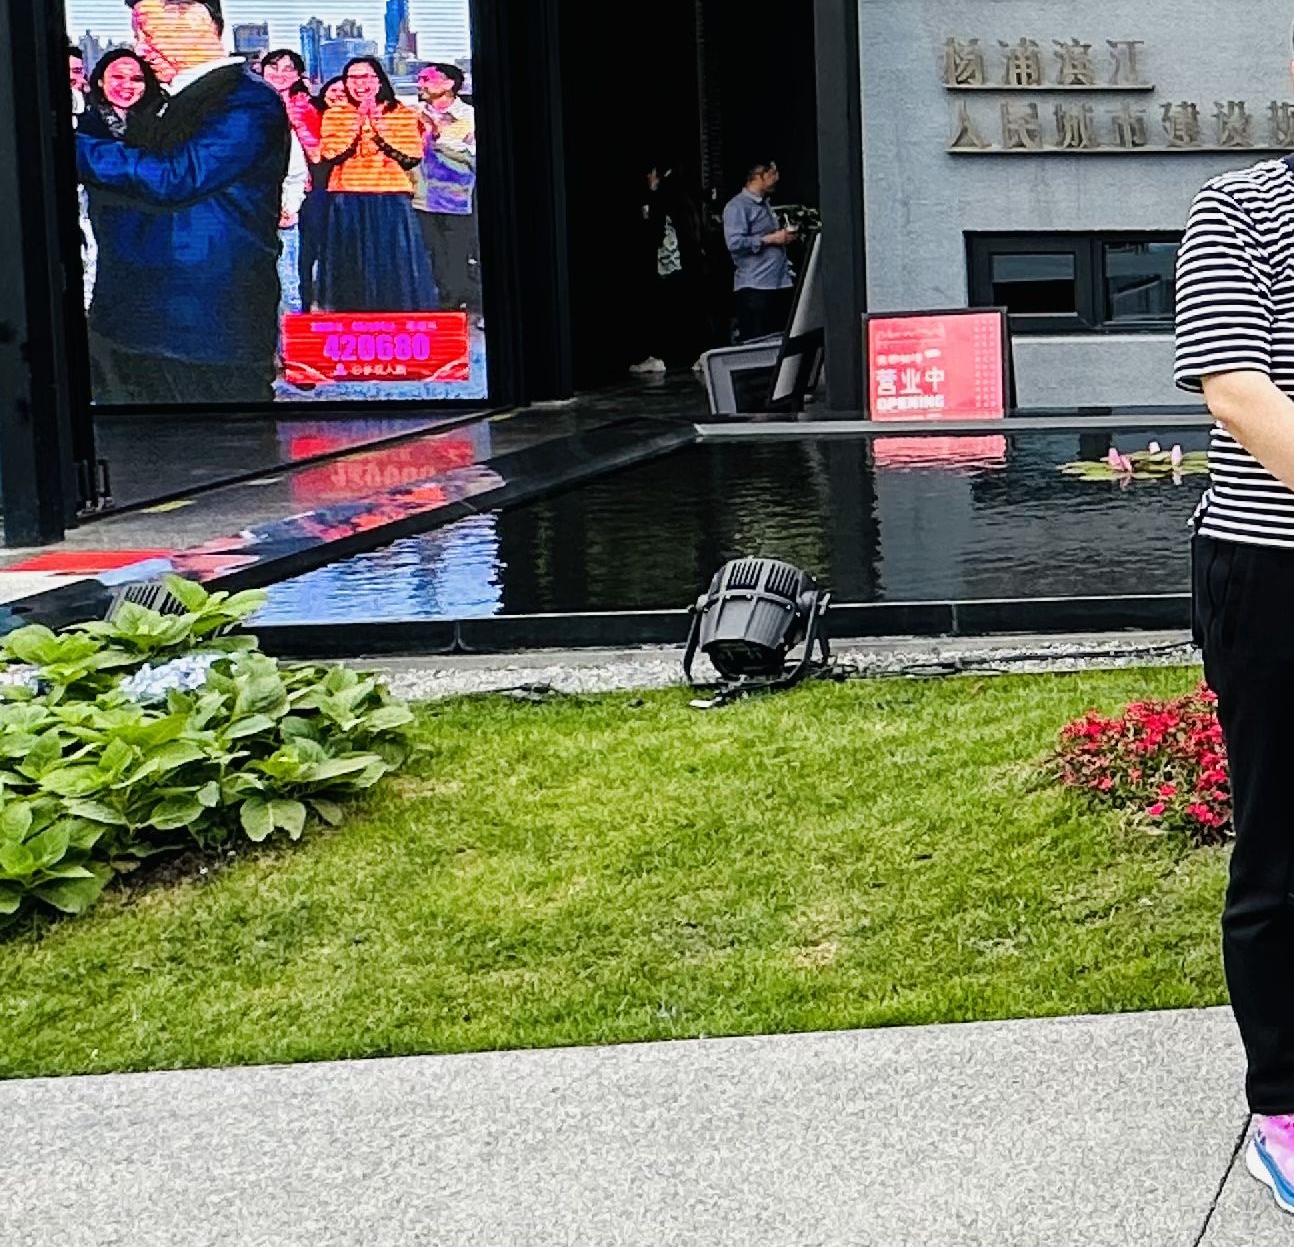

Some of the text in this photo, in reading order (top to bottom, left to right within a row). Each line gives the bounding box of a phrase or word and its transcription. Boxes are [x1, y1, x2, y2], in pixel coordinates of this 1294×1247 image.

[943, 37, 1145, 85] 杨浦滨江
[324, 334, 430, 361] 420680
[876, 368, 944, 395] 营业中
